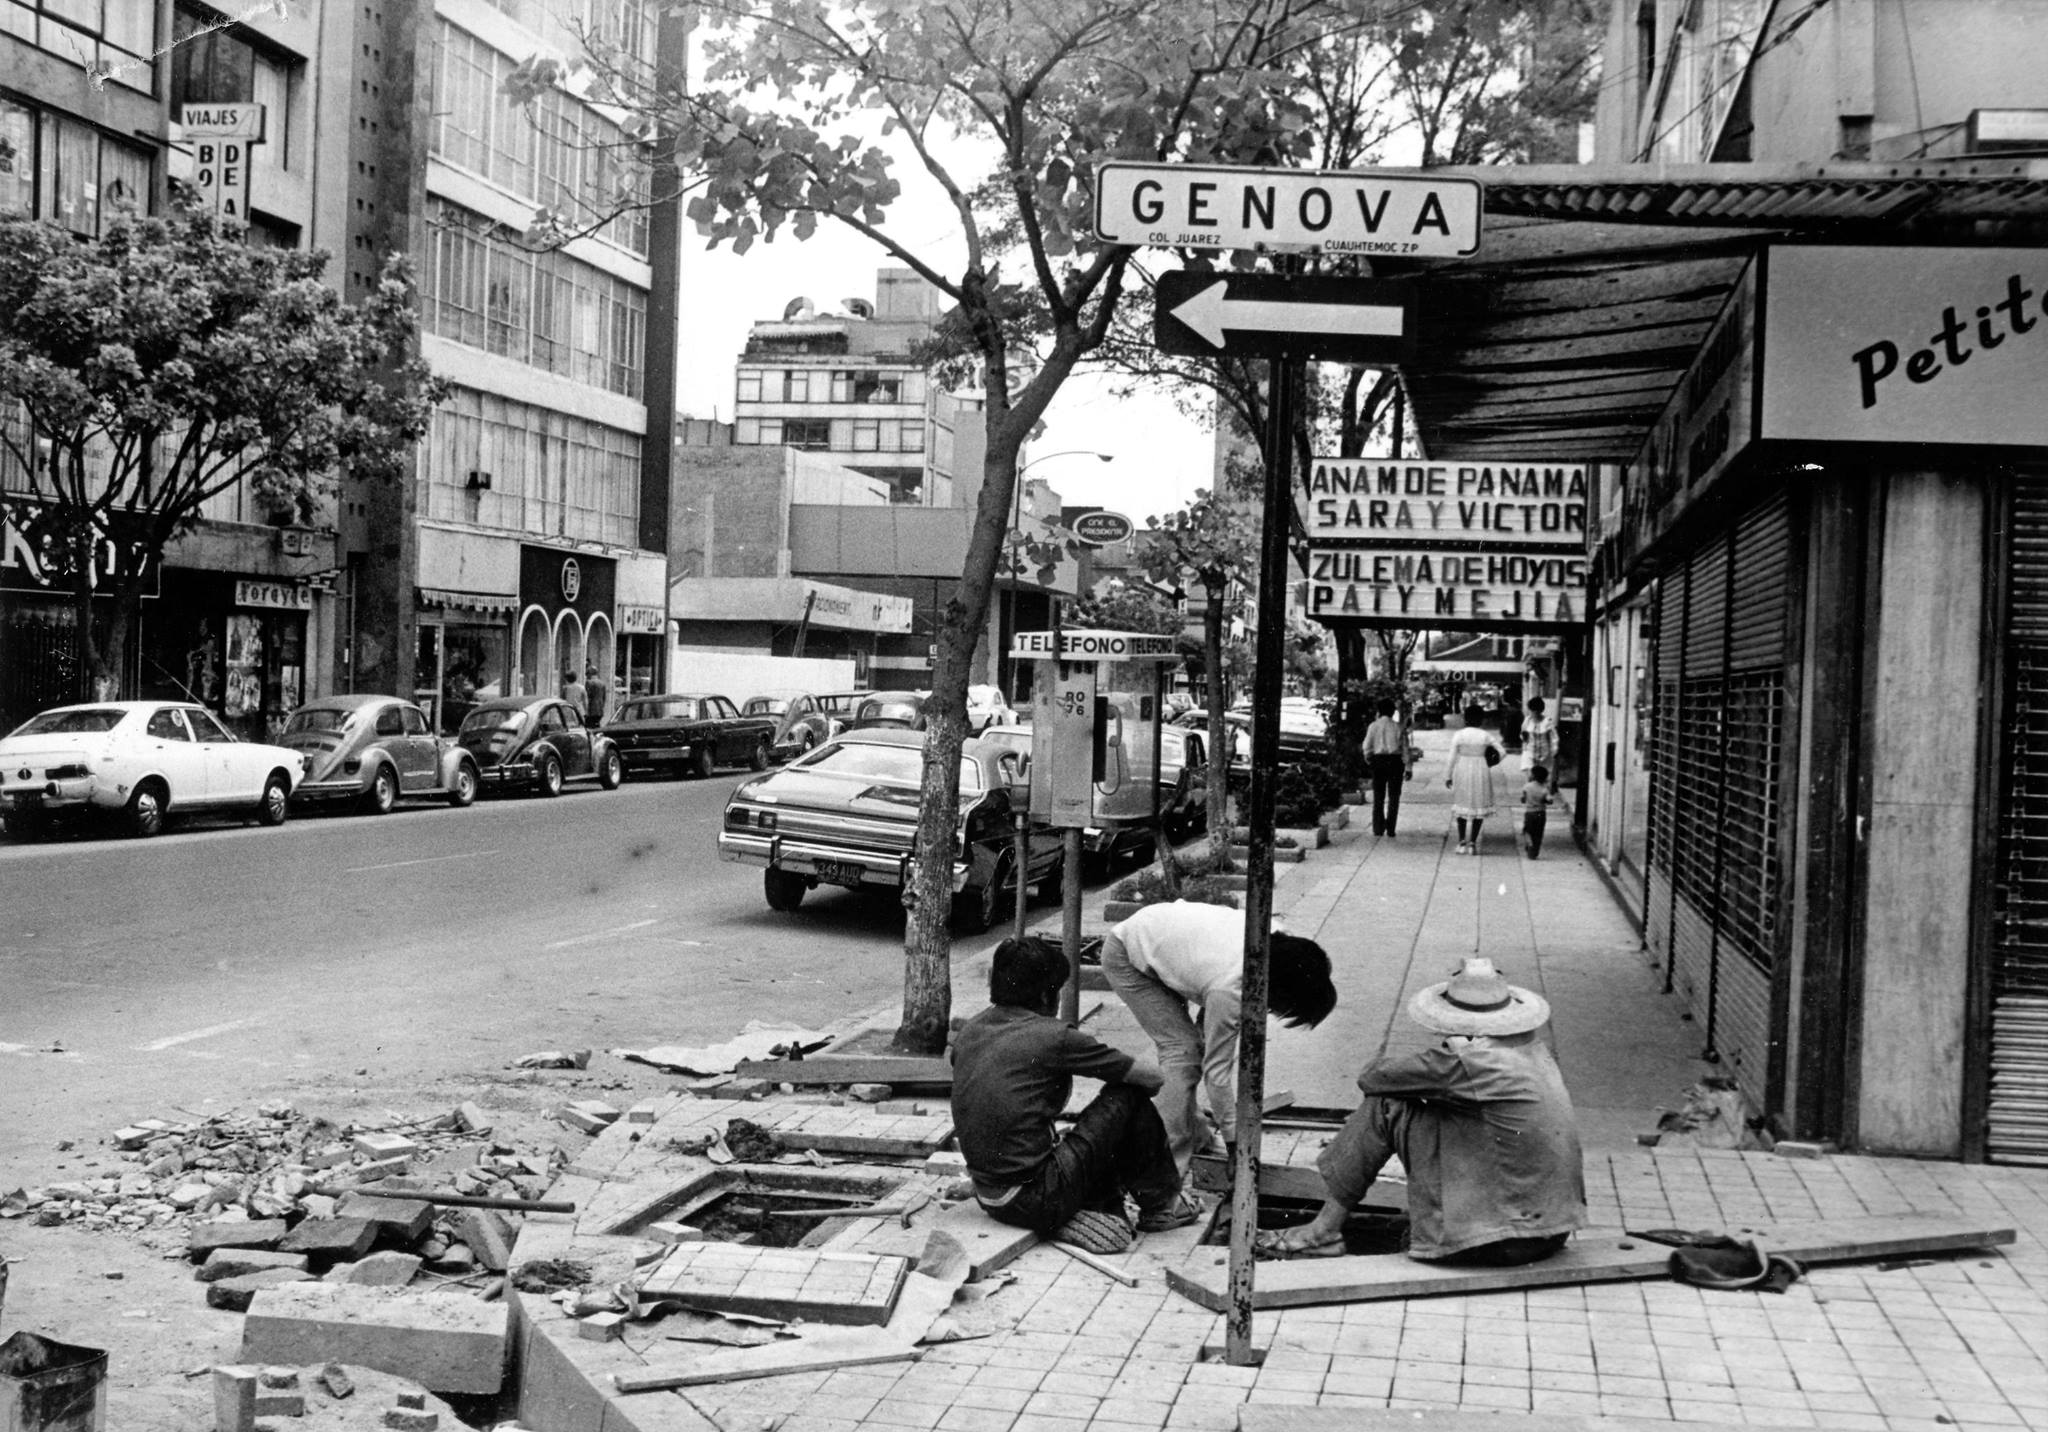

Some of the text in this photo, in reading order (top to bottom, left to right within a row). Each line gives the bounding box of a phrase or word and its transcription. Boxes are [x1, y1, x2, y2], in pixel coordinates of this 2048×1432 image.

[186, 109, 237, 125] VIAJES
[1132, 179, 1450, 236] GENOVA
[1149, 232, 1221, 245] COL JUAREZ
[1325, 240, 1398, 252] CUAUHTEMOC
[1852, 274, 2048, 409] Petit
[1457, 467, 1586, 498] PANAMA
[1318, 499, 1585, 532] SARA Y VICTOR
[1313, 553, 1435, 584] ZULEMA
[1313, 584, 1574, 622] PATY MEJIA
[1018, 634, 1126, 654] TELEFONO
[1131, 638, 1173, 655] TELEFONO
[1066, 704, 1085, 716] 76
